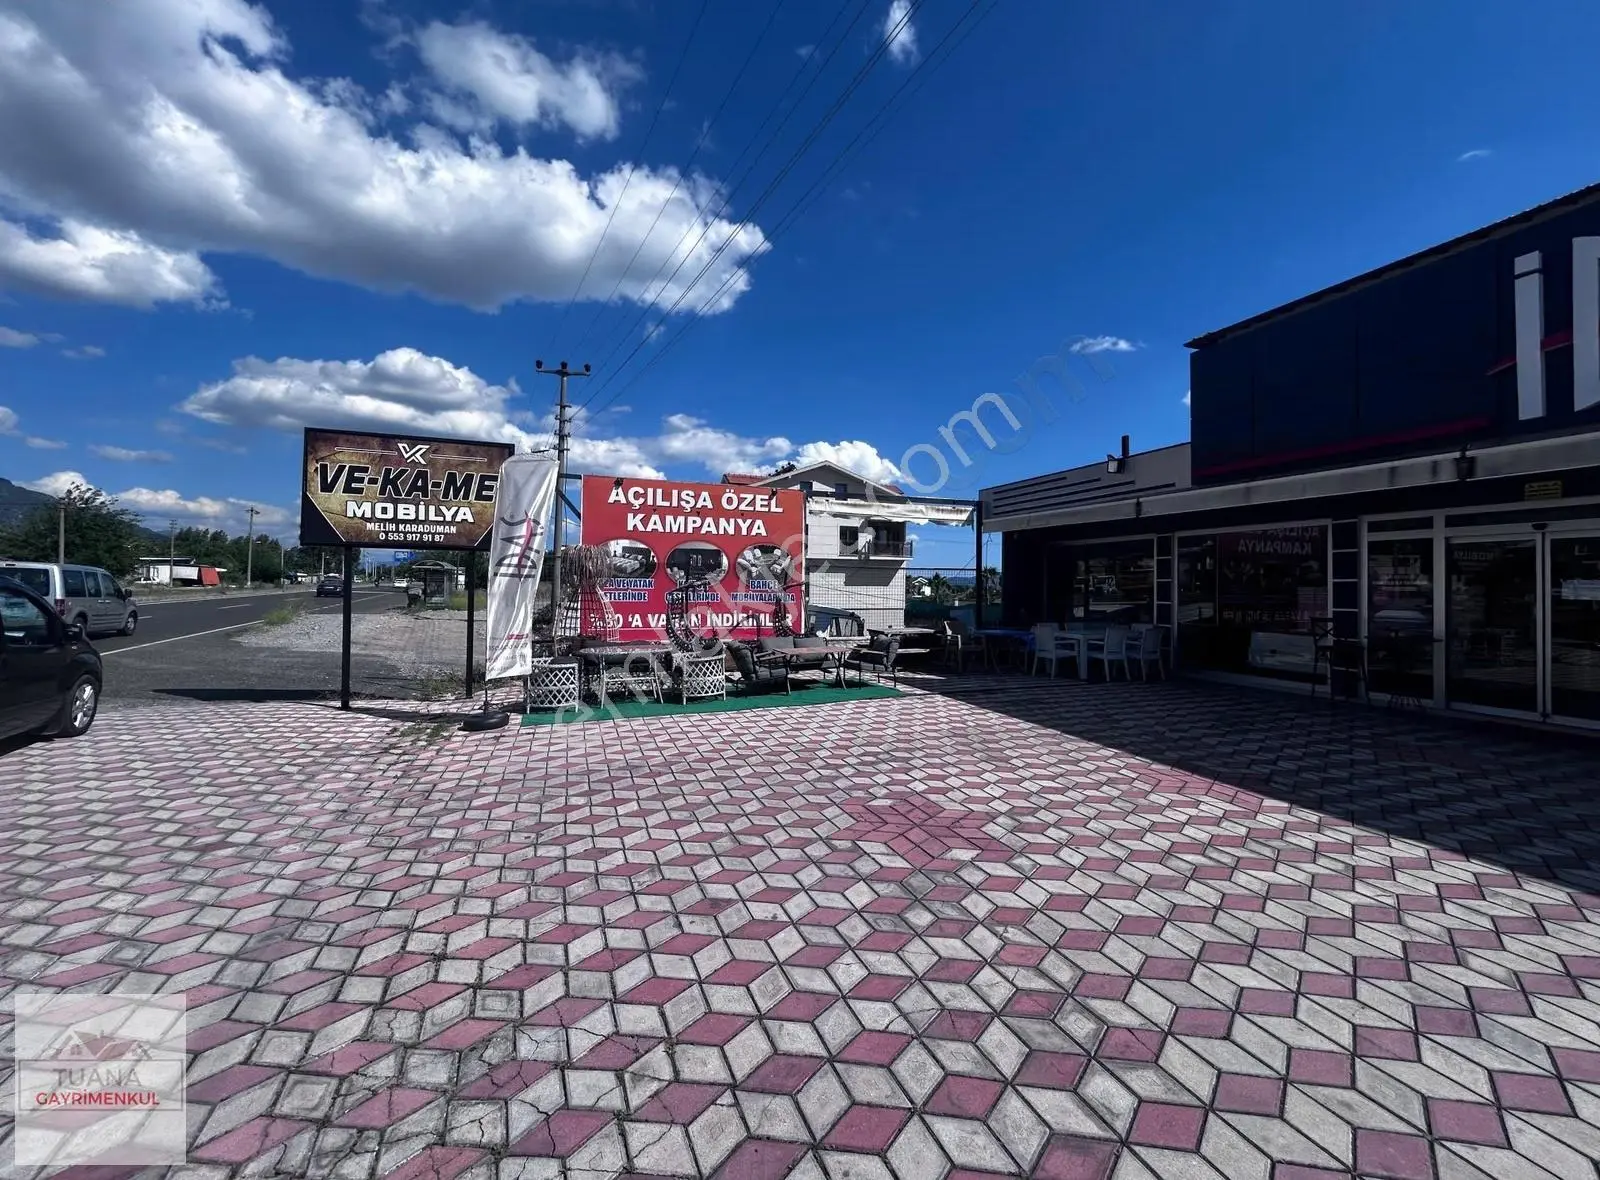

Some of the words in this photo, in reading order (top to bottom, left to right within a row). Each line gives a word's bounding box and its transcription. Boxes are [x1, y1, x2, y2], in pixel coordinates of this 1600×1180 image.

[318, 462, 499, 503] VE-KA-ME
[608, 486, 712, 512] AÇILIŞA
[721, 488, 783, 513] ÖZEL
[346, 501, 475, 523] MOBİLYA
[366, 522, 396, 532] MELİH
[398, 523, 457, 534] KARADUMAN
[627, 513, 768, 537] KAMPANYA
[379, 532, 385, 540] 0
[387, 532, 404, 541] 553
[406, 533, 420, 541] 917
[422, 534, 432, 542] 91
[434, 534, 445, 542] 87
[628, 577, 655, 589] YATAK
